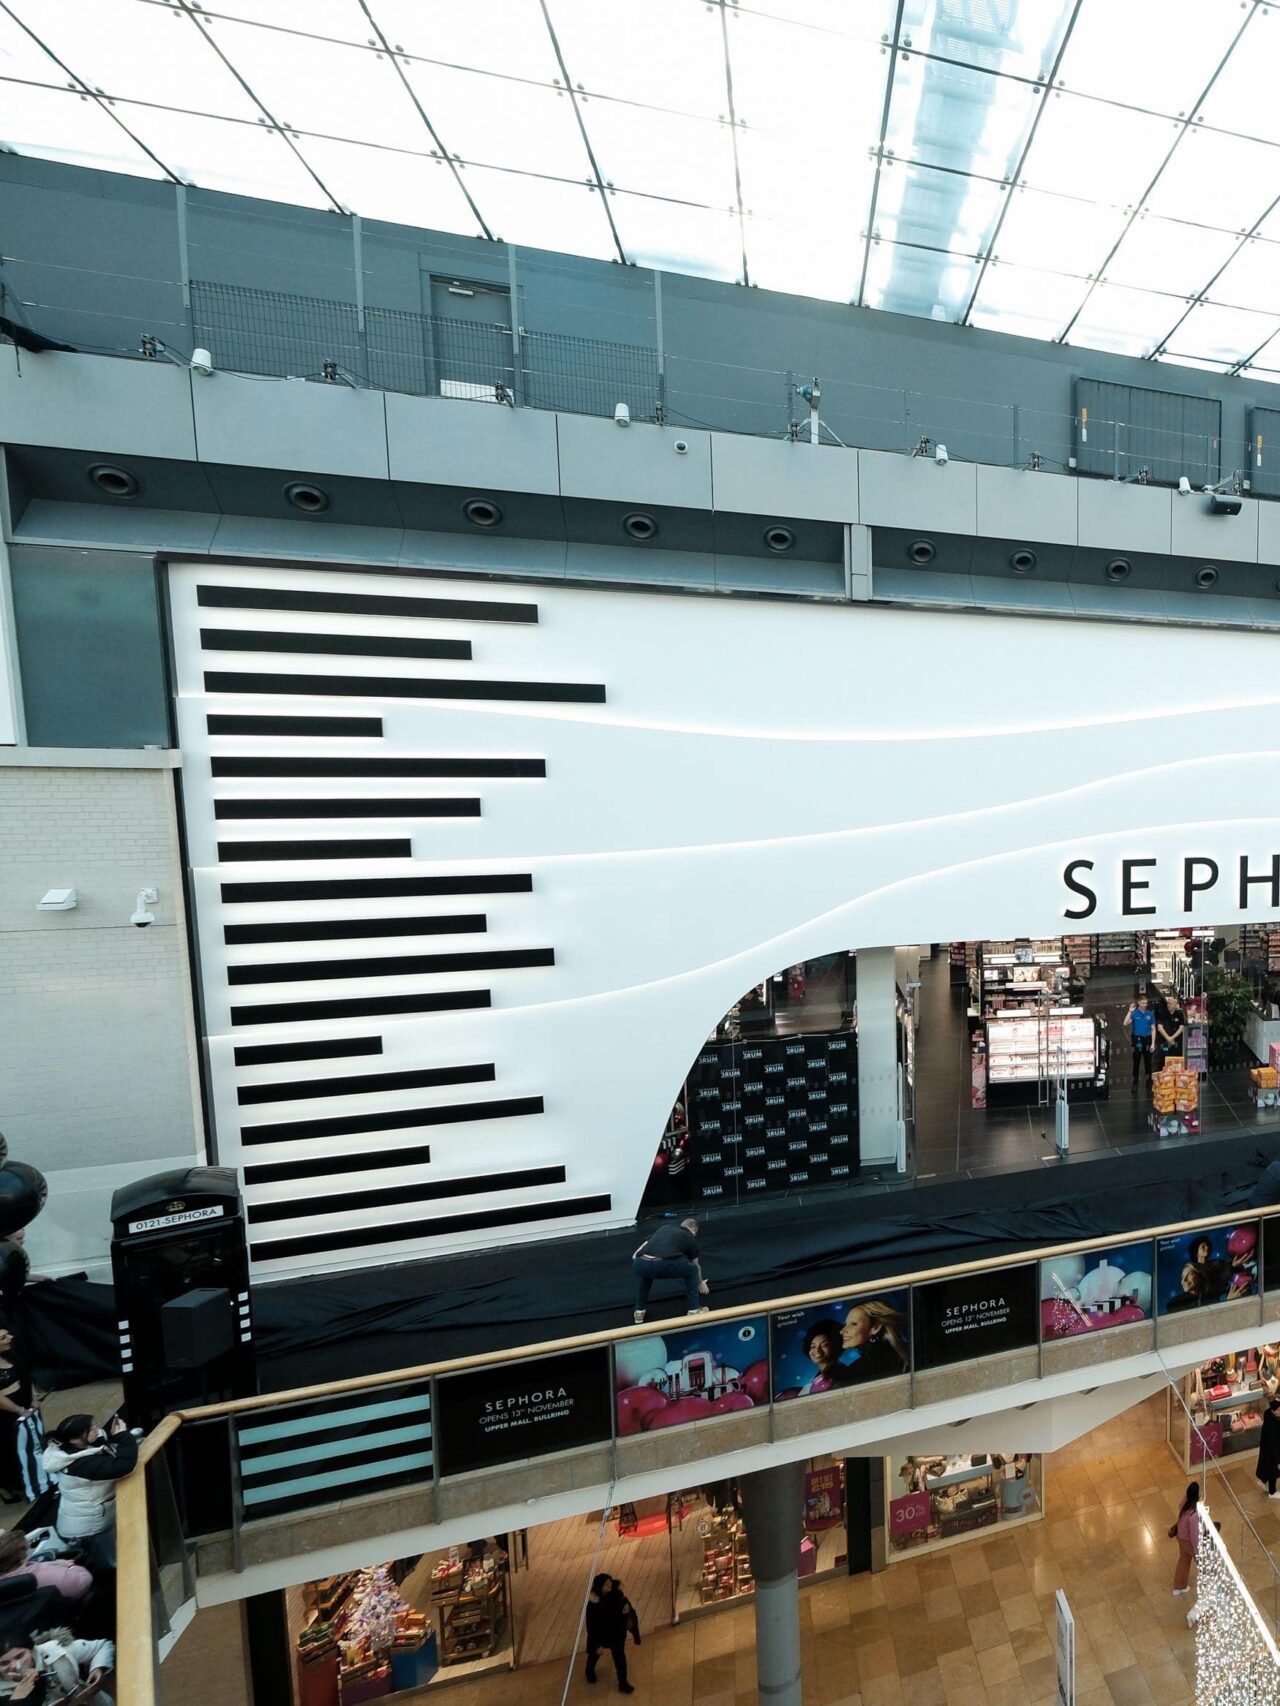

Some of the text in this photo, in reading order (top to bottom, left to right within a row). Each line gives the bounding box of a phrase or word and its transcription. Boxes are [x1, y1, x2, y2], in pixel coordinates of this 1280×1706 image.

[136, 1208, 217, 1230] 0121-SEPHORA
[946, 1298, 1006, 1317] SEPHORA
[976, 1307, 1011, 1320] NOVEMBER
[485, 1387, 567, 1412] SEPHORA
[479, 1412, 509, 1424] OPENS
[527, 1398, 574, 1414] NOVEMBER
[485, 1422, 509, 1432] UPPER
[534, 1409, 570, 1422] BULLRING
